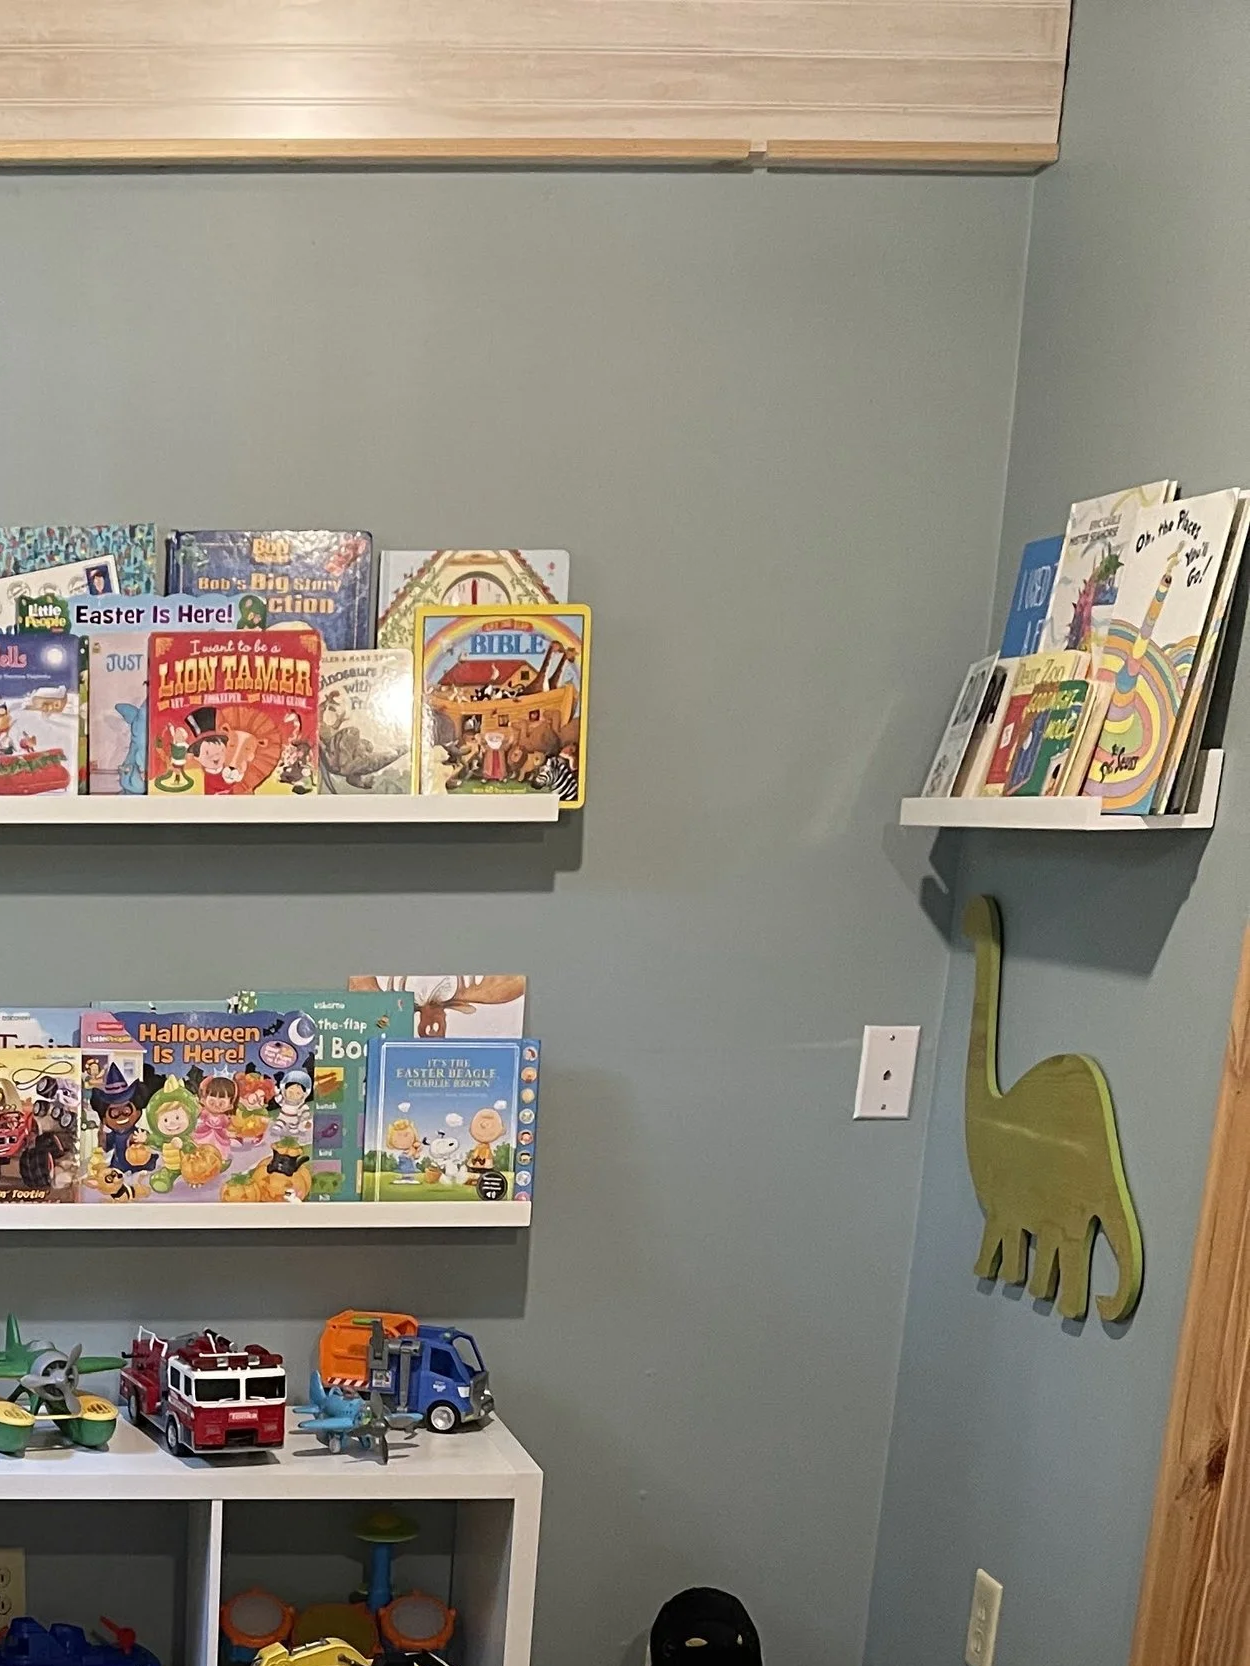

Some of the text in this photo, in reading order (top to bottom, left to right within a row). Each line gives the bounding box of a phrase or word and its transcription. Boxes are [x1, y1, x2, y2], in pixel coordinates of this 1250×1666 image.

[1158, 520, 1174, 537] the
[1177, 509, 1202, 540] Places
[1187, 554, 1214, 588] Go!
[197, 576, 247, 591] Bob's
[250, 572, 290, 594] Big
[27, 603, 63, 617] Little
[75, 604, 233, 625] Easter Is Here!
[268, 594, 336, 615] ction
[24, 614, 68, 629] People
[202, 640, 235, 654] want
[237, 640, 252, 653] to
[253, 638, 268, 653] be
[270, 645, 281, 654] a
[468, 633, 546, 655] BIBLE
[106, 653, 144, 673] JUST
[158, 655, 313, 698] LION TAMER
[138, 1022, 261, 1044] Halloween
[317, 1017, 368, 1034] the-flap
[153, 1044, 175, 1064] Is
[183, 1043, 245, 1064] Here!
[331, 1035, 368, 1060] Bo
[396, 1068, 445, 1079] EASTER
[450, 1058, 471, 1068] THE
[406, 1079, 491, 1088] CHARLIE BROWN
